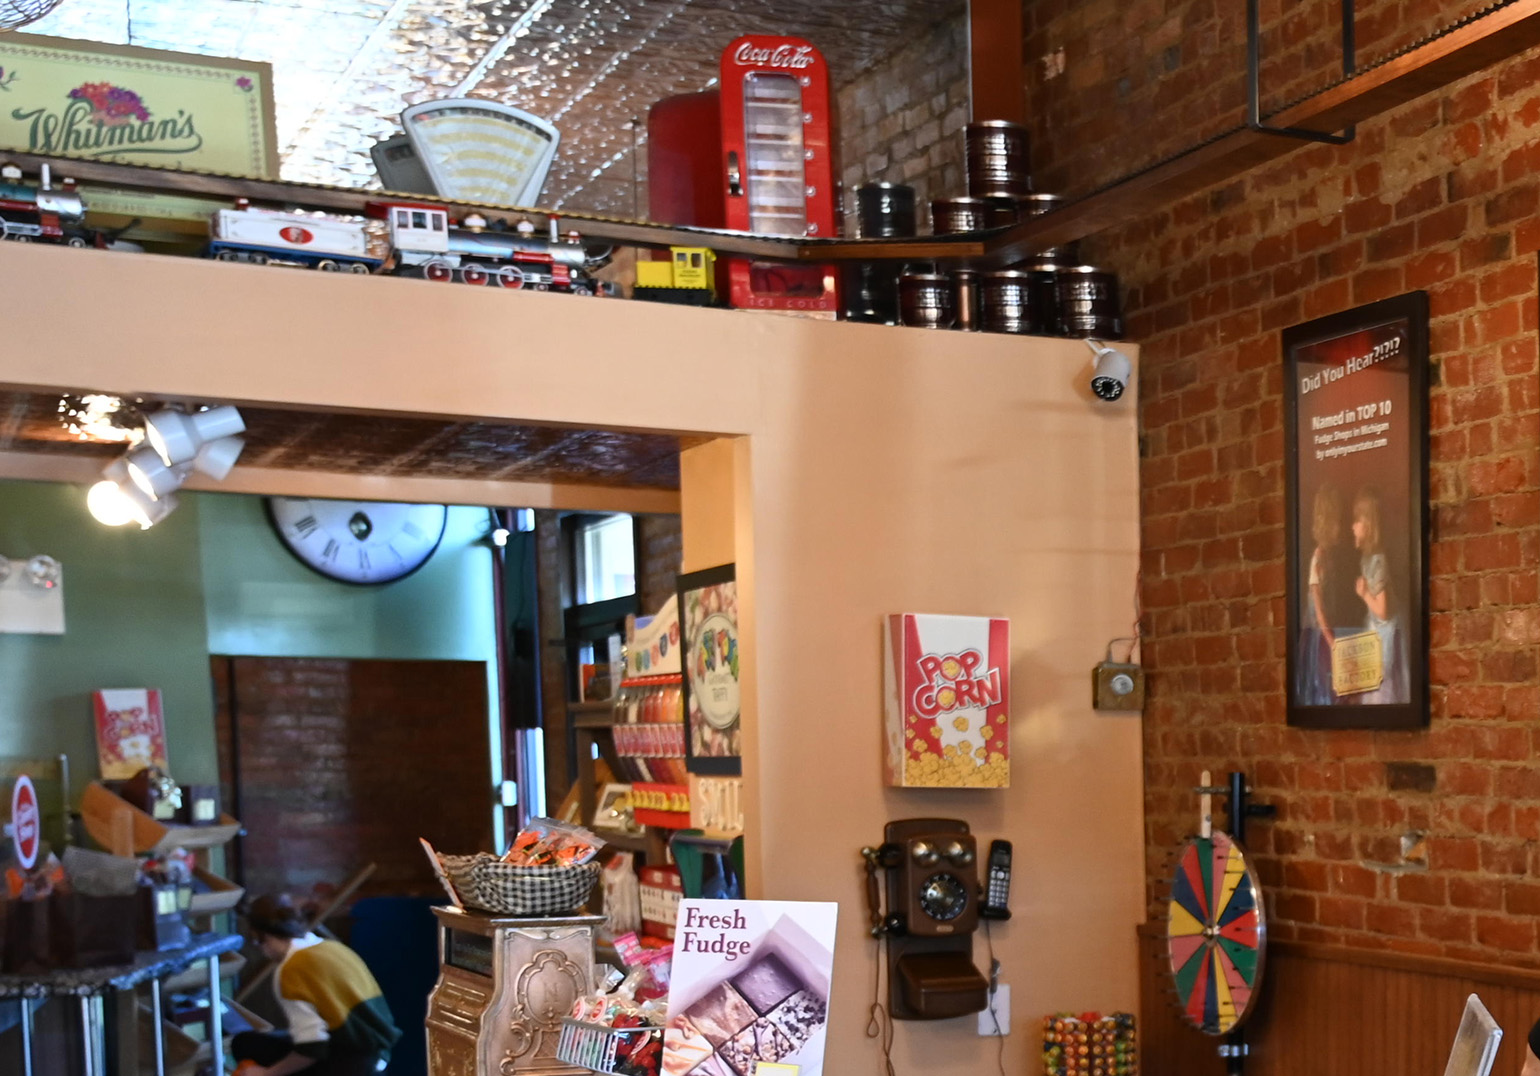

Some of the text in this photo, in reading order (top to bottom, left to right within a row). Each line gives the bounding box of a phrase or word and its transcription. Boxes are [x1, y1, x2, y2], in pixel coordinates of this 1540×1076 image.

[12, 99, 203, 156] Whitman's
[1302, 372, 1320, 394] Did
[1322, 365, 1344, 384] You
[1312, 400, 1392, 430] Named in TOP 10
[1314, 433, 1333, 445] Fudge
[1360, 422, 1389, 434] Michigan
[917, 649, 982, 683] POP
[914, 668, 1001, 718] CORN
[685, 907, 747, 929] Fresh
[682, 932, 751, 960] Fudge
